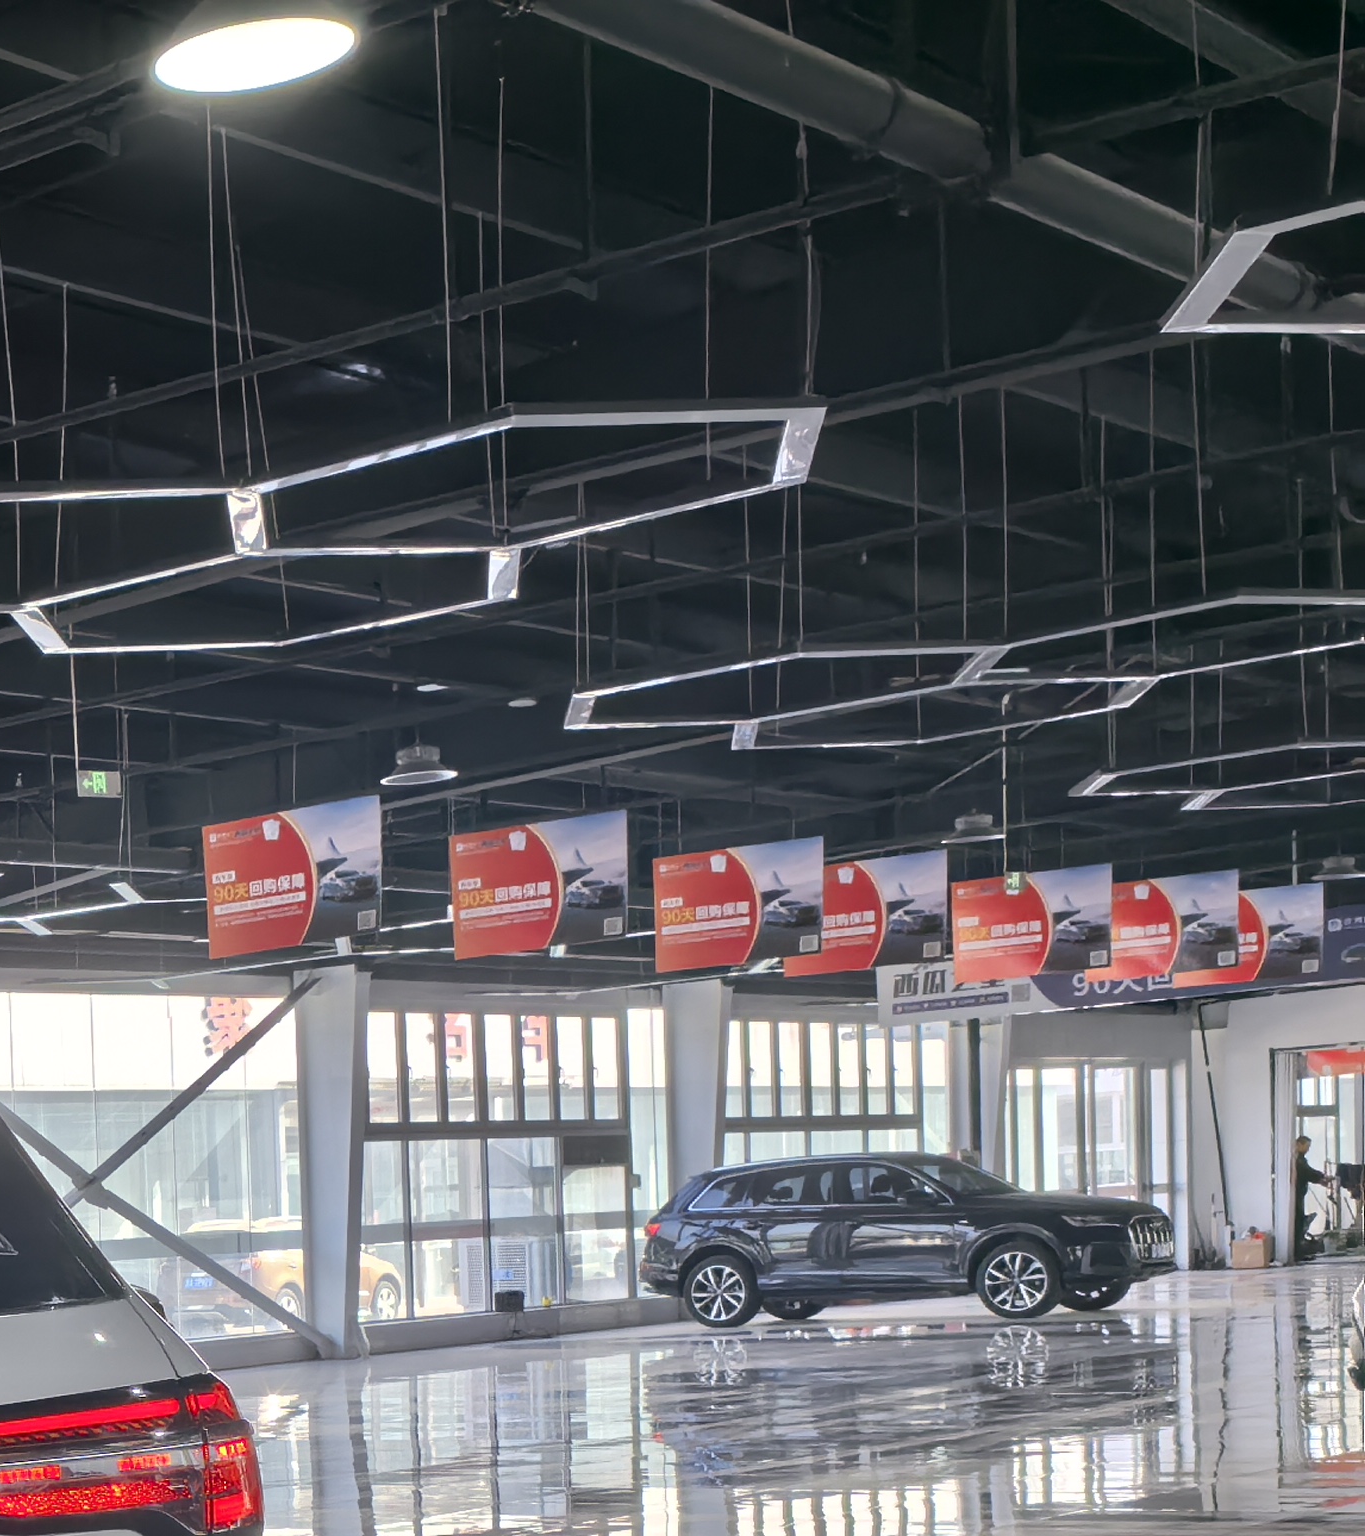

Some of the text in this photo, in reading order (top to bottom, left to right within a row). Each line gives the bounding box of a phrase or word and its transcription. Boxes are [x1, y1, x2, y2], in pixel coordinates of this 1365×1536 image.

[213, 872, 306, 903] 90天回购保障
[458, 880, 552, 908] 90天回购保障
